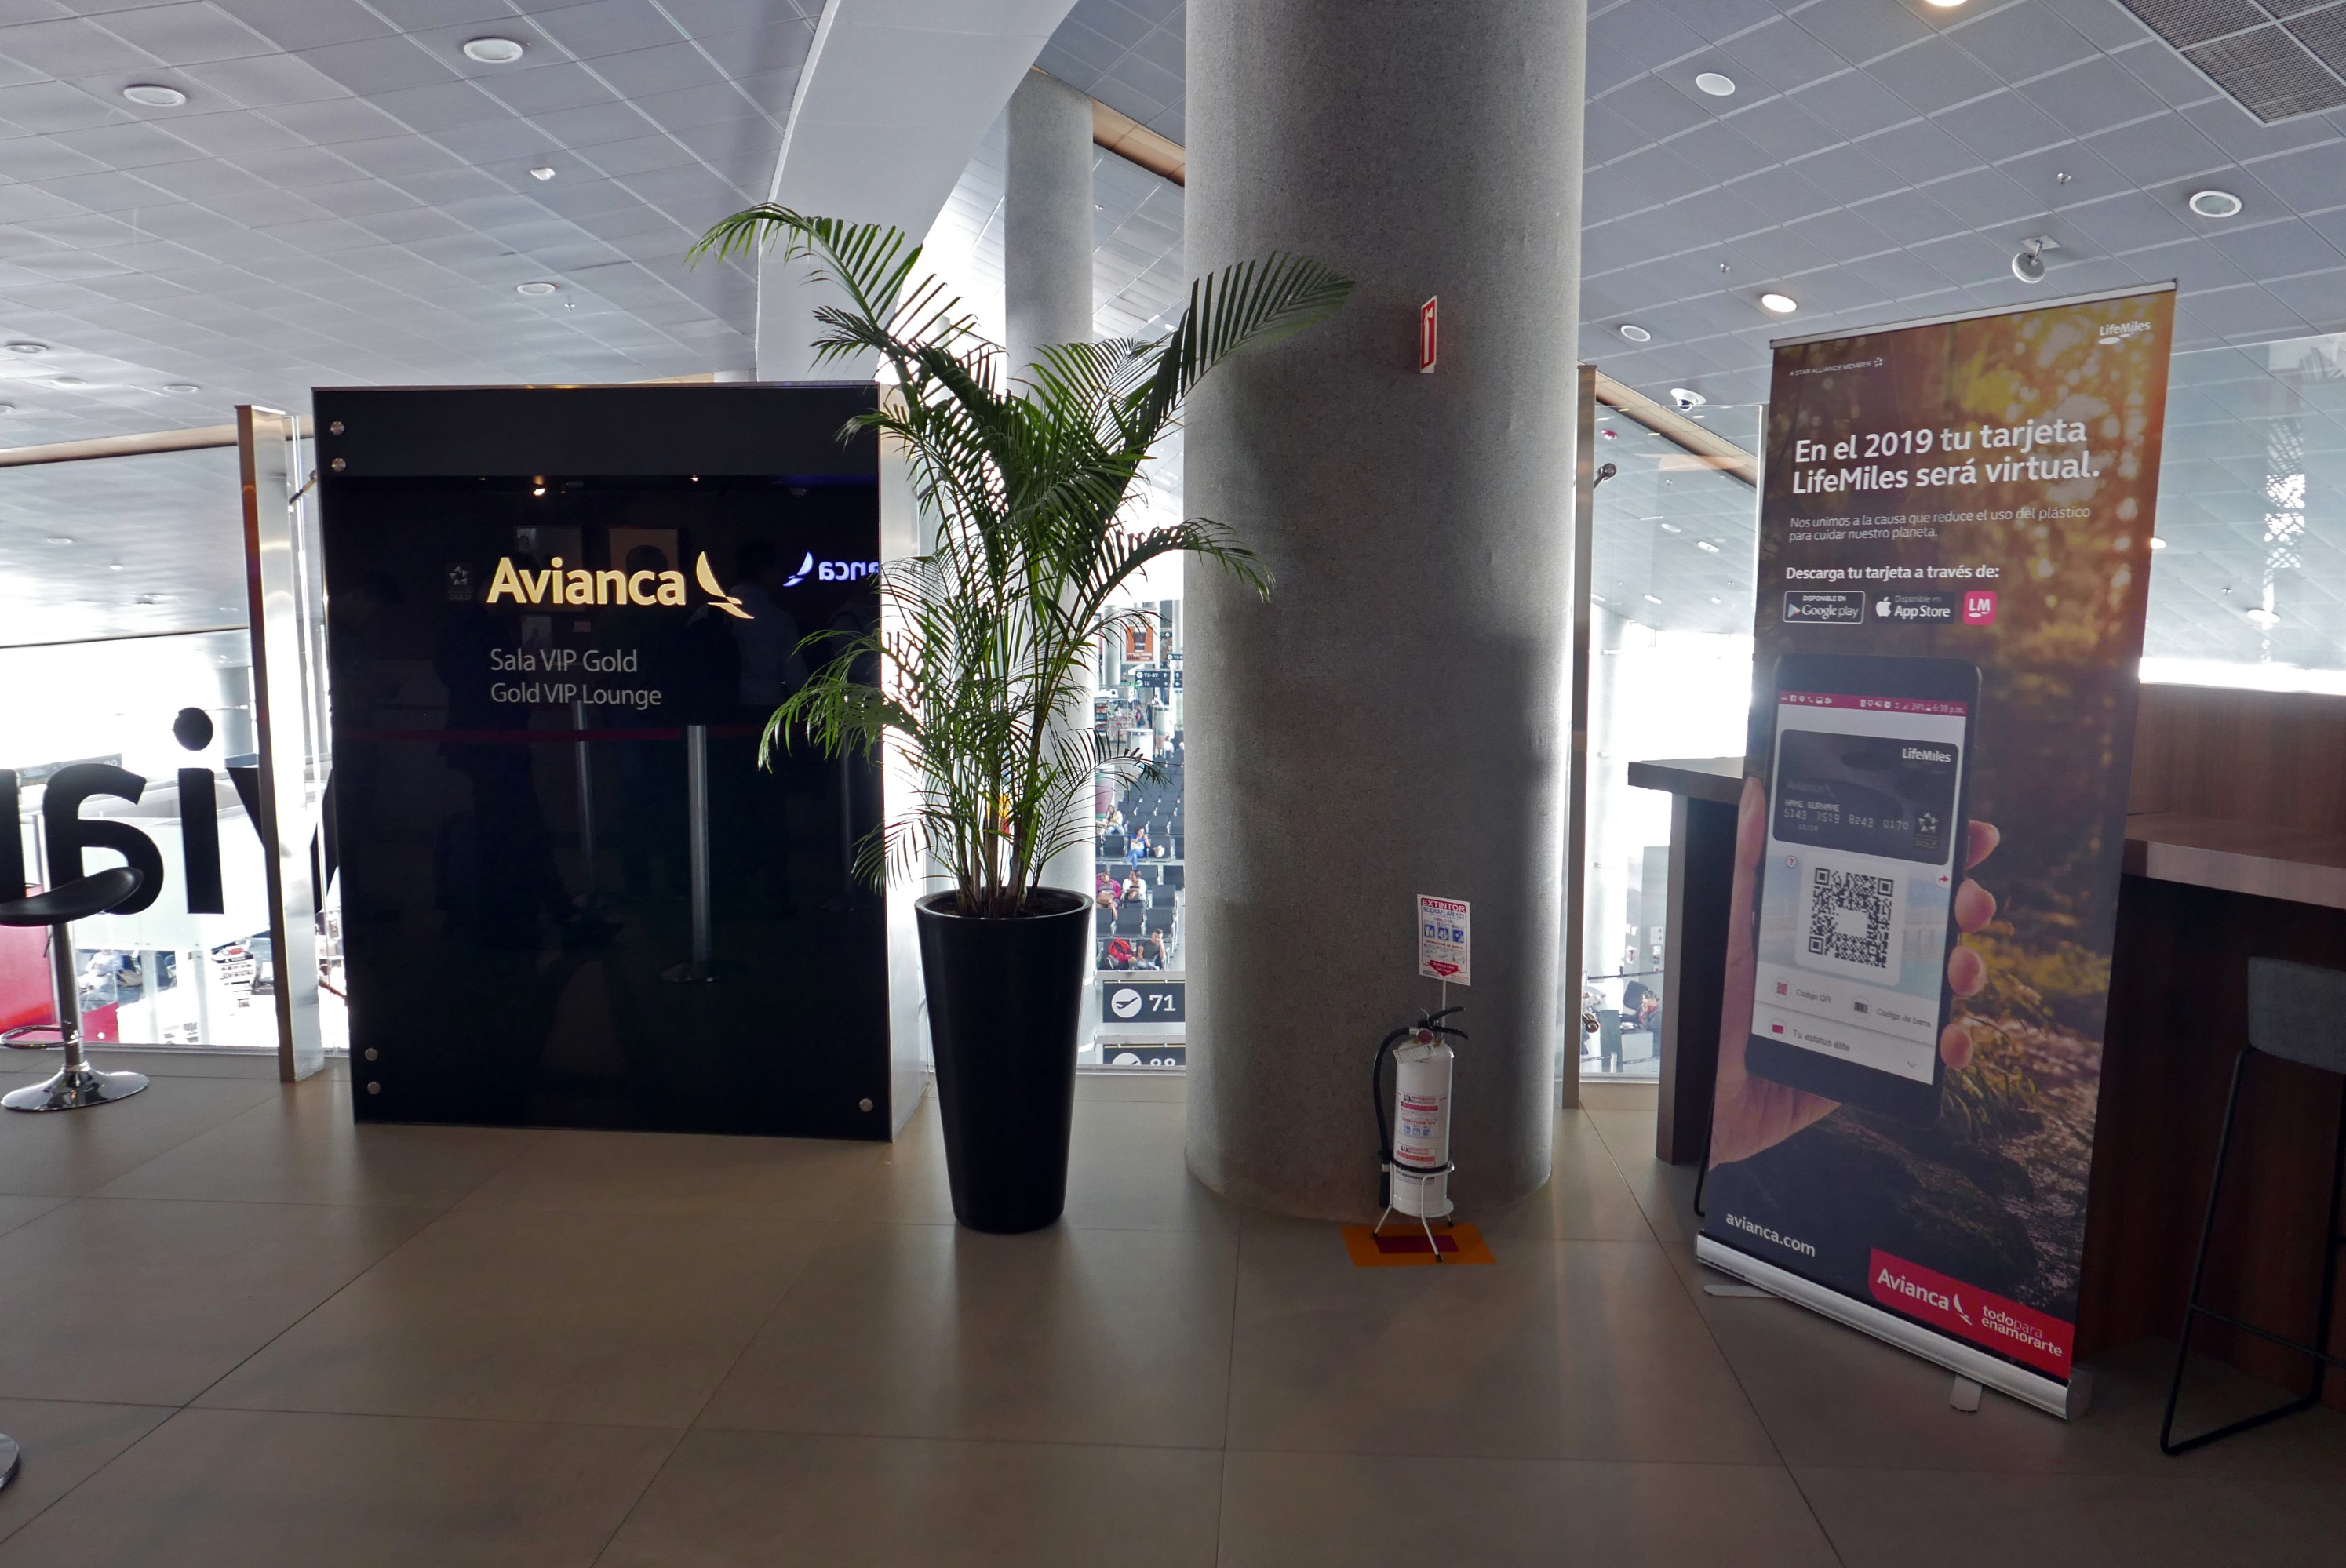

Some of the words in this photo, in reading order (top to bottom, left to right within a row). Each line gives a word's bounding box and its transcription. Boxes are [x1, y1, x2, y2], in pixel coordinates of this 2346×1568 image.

[2100, 321, 2151, 336] LifeMiles
[1812, 365, 1841, 373] ALLIANCE
[1843, 361, 1871, 370] MEMBER
[1795, 439, 1827, 463] En
[1833, 435, 1858, 460] el
[1864, 428, 1933, 457] 2019
[1940, 428, 1972, 451] tu
[1980, 418, 2087, 453] tarjeta
[1793, 465, 1909, 494] LifeMiles
[1916, 457, 1977, 486] será
[1985, 450, 2100, 482] virtual.
[1790, 518, 1810, 528] Nos
[1812, 516, 1851, 527] unimos
[1852, 517, 1860, 526] a
[1862, 515, 1872, 526] la
[1874, 515, 1907, 526] causa
[1908, 514, 1931, 526] que
[1933, 511, 1973, 522] reduce
[1976, 509, 1987, 521] el
[1991, 511, 2013, 520] uso
[2016, 508, 2035, 519] del
[2038, 507, 2091, 521] plástico
[1789, 532, 1812, 543] para
[1814, 529, 1845, 540] cuidar
[1848, 529, 1889, 540] nuestro
[1892, 526, 1938, 540] planeta.
[486, 556, 687, 606] Avianca
[1786, 567, 1845, 582] Descarga
[1848, 567, 1862, 579] tu
[1865, 566, 1911, 582] tarjeta
[1914, 568, 1924, 578] a
[1927, 564, 1972, 578] través
[1975, 564, 2000, 578] de:
[1895, 595, 1931, 603] Disponible
[1969, 598, 1991, 611] LM
[1801, 604, 1838, 619] Google
[1838, 606, 1859, 618] play
[1894, 605, 1918, 619] App
[1919, 605, 1951, 617] Store
[490, 648, 536, 671] Sala
[540, 649, 577, 671] VIP
[582, 649, 637, 672] Gold
[491, 682, 540, 703] Gold
[543, 683, 577, 703] VIP
[583, 683, 661, 711] Lounge
[1902, 747, 1952, 762] LifeMiles
[1785, 799, 1804, 809] NAME
[1807, 801, 1841, 812] SURNAME
[1783, 809, 1808, 820] 5143
[1816, 812, 1841, 824] 7519
[1849, 814, 1874, 828] 8243
[1883, 820, 1909, 831] 0170
[1422, 899, 1465, 913] EXTINTOR
[1423, 906, 1455, 916] SOLKAFLAM
[1149, 995, 1176, 1012] 71
[1820, 994, 1831, 1003] QR
[1793, 1028, 1804, 1039] Tu
[1804, 1033, 1832, 1047] estatus
[1725, 1213, 1816, 1257] avianca.com
[1877, 1268, 1951, 1312] Avianca
[1981, 1318, 2063, 1357] enamorarte
